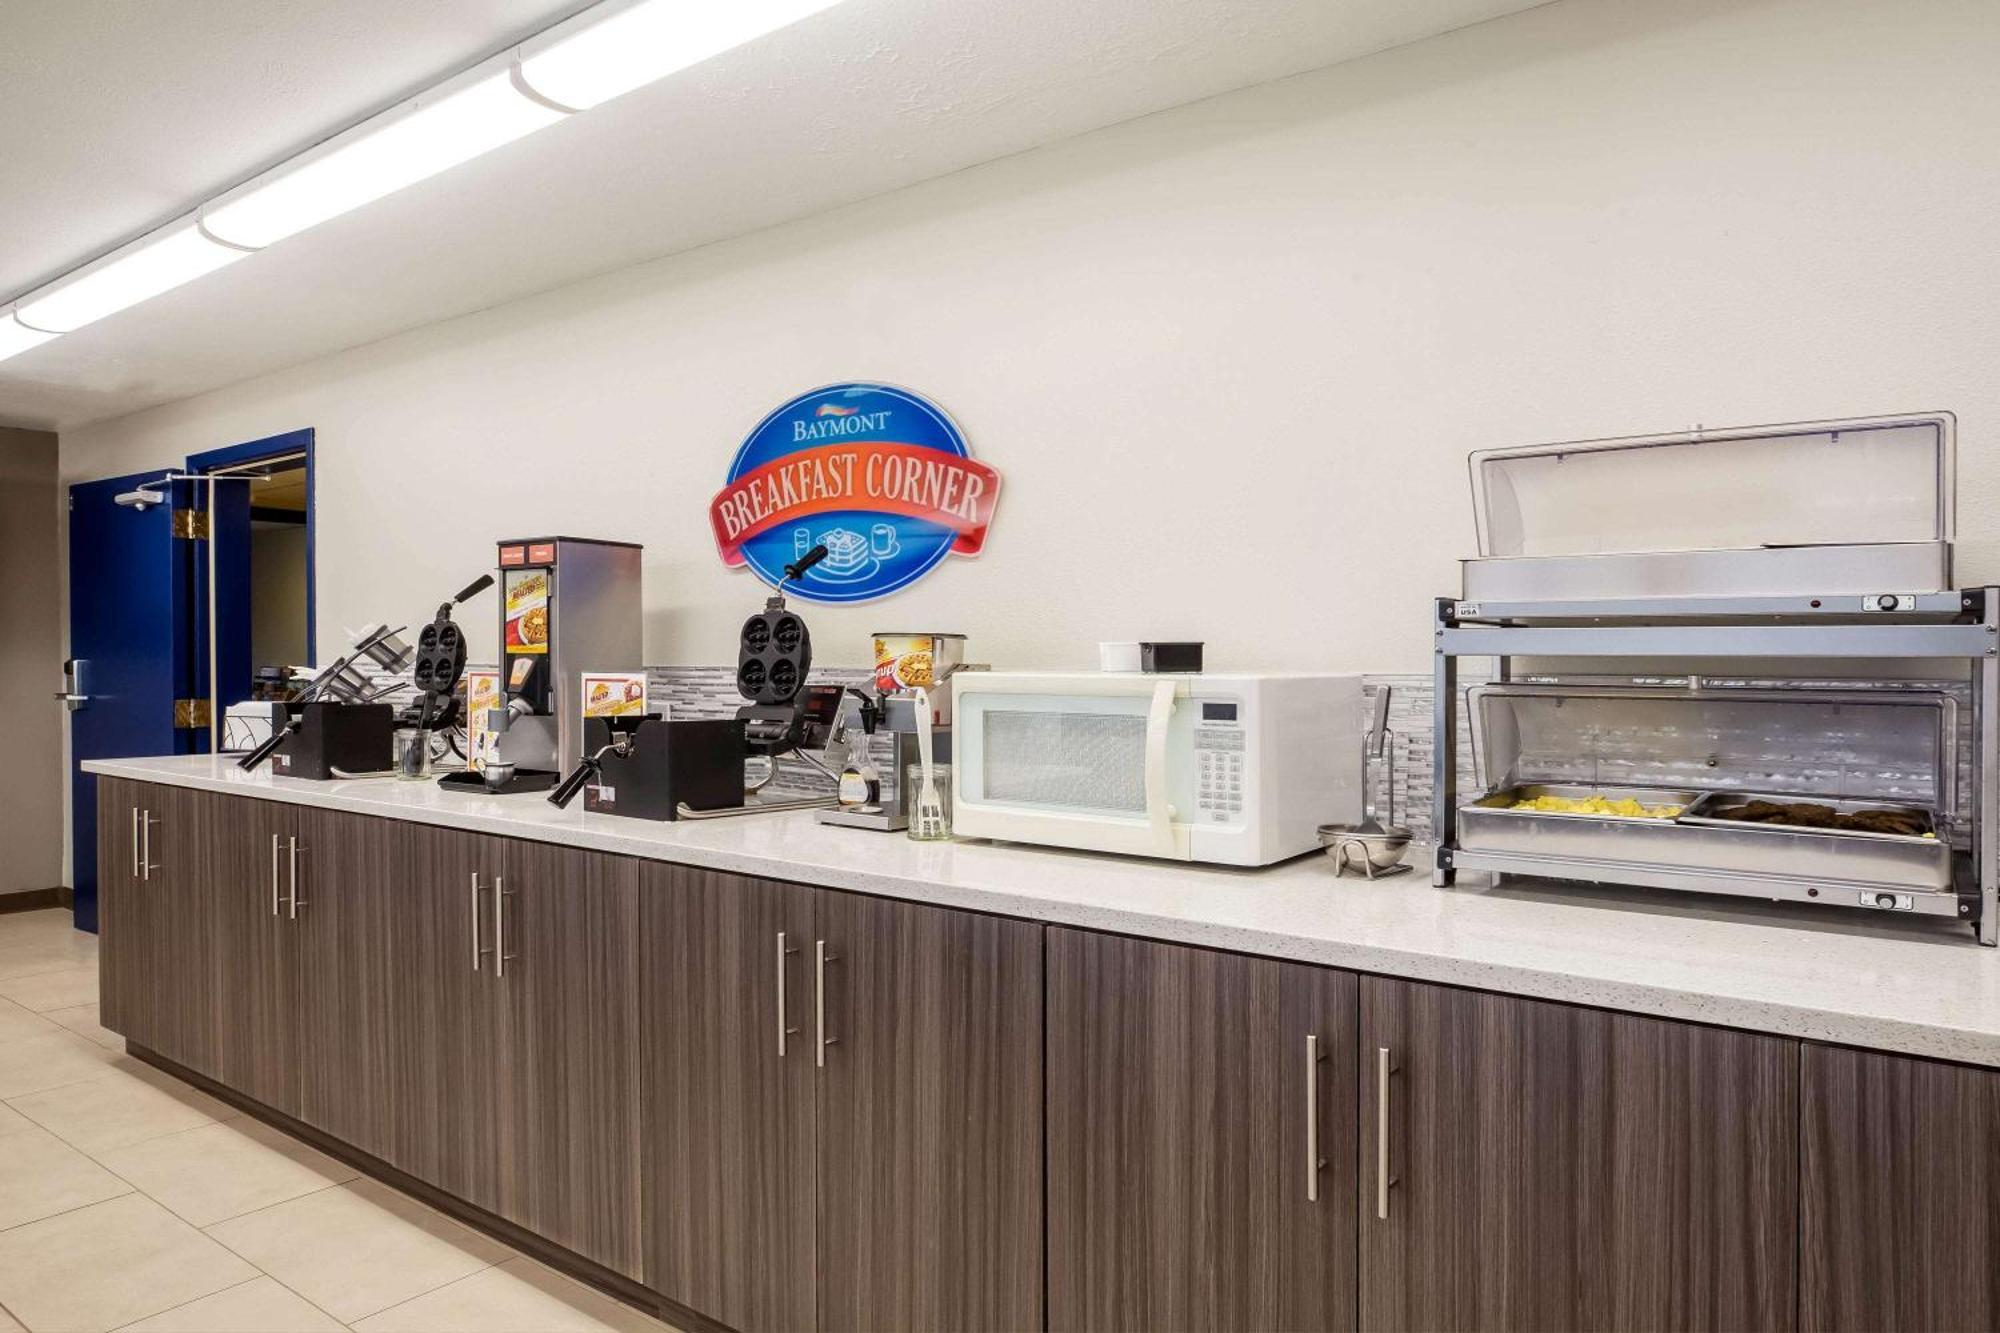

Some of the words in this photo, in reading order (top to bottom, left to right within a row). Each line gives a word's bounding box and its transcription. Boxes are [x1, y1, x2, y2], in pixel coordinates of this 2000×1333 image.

[793, 412, 888, 441] BAYMONT
[719, 453, 858, 540] BREAKFAST
[866, 453, 984, 523] CORNER
